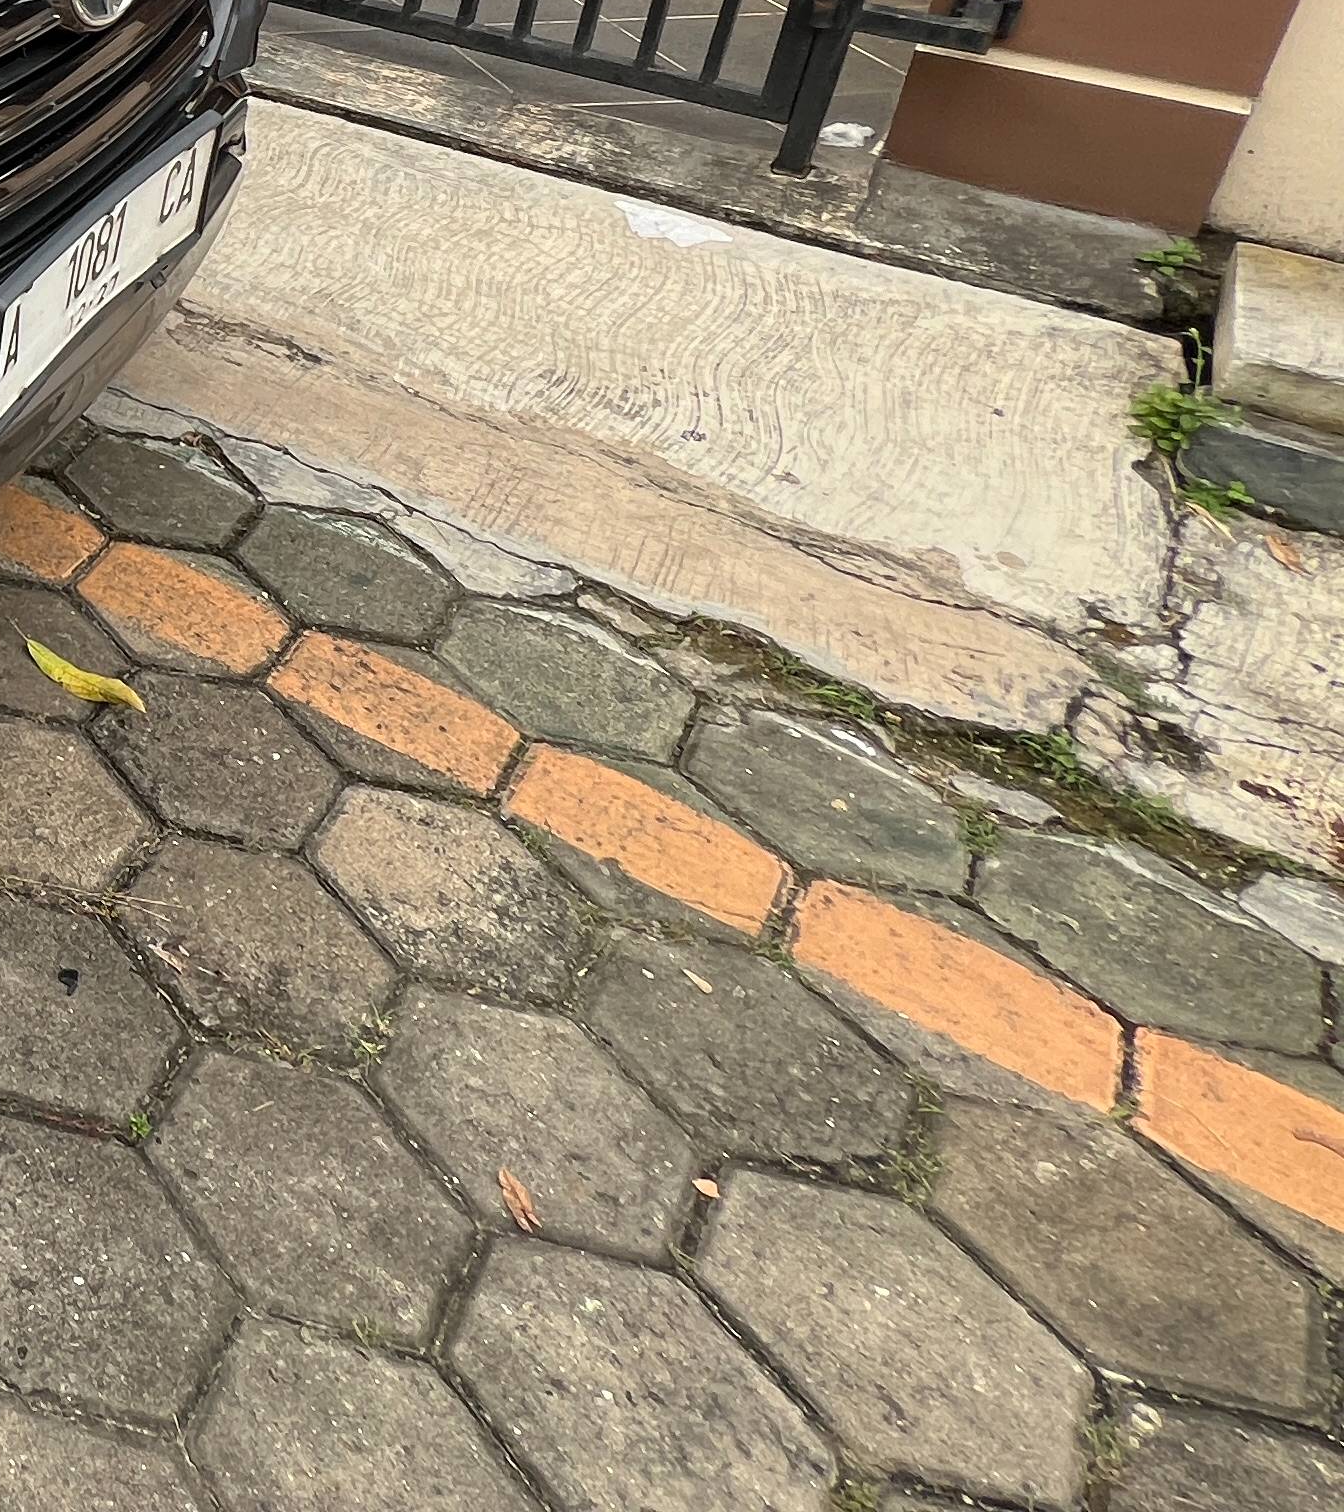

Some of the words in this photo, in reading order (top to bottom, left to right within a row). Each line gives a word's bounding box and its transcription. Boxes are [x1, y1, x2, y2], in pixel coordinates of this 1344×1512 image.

[1, 303, 21, 379] A
[65, 201, 128, 309] 1081
[159, 148, 197, 223] CA
